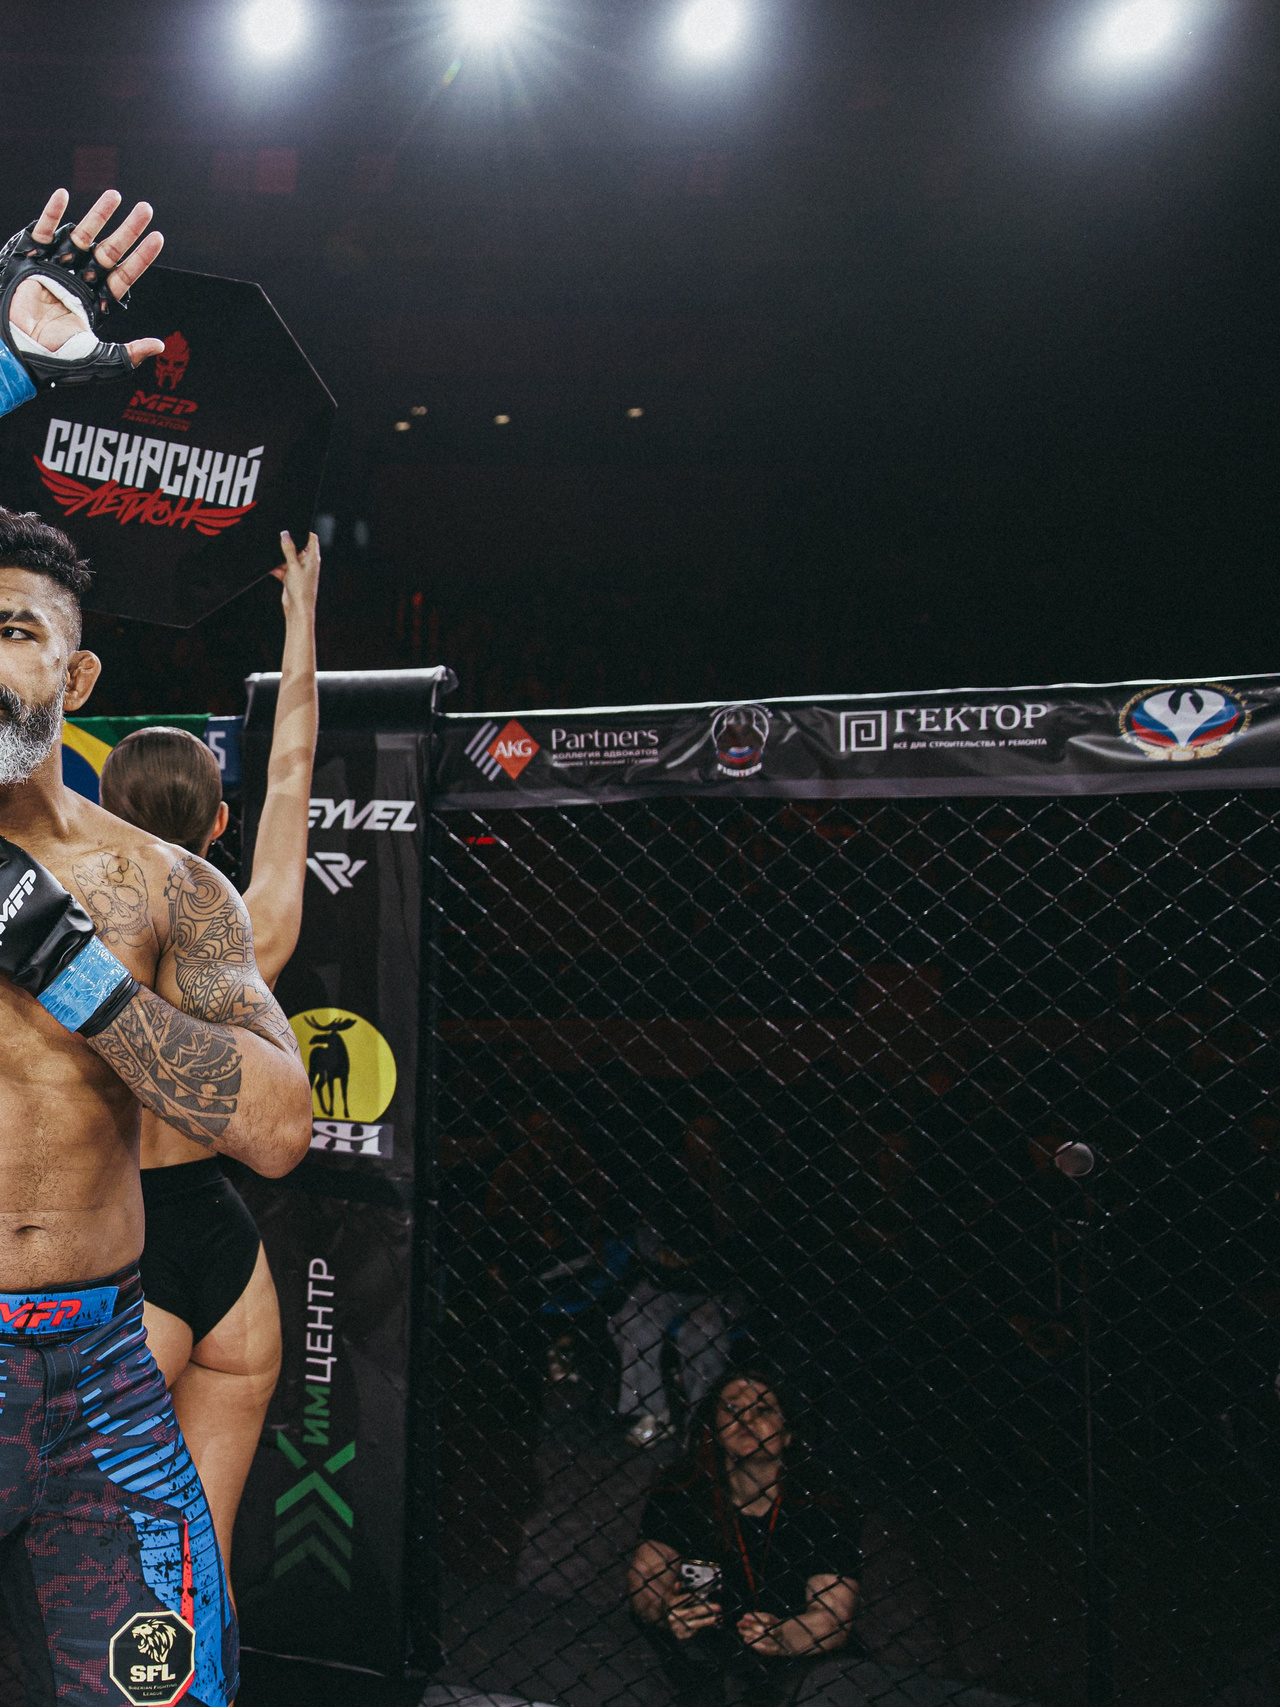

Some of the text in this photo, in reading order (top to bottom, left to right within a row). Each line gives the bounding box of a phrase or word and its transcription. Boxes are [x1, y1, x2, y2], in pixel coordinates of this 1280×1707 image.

[129, 390, 198, 415] MFP
[42, 418, 265, 507] СИБИРСКИЙ
[894, 704, 1048, 733] ГЕКТОР
[493, 738, 533, 759] AKG
[551, 728, 660, 750] Partners
[910, 741, 926, 750] ДЛЯ
[929, 740, 996, 749] СТРОИТЕЛЬСТВА
[1008, 738, 1048, 747] РЕМОНТА
[130, 1663, 176, 1683] SFL
